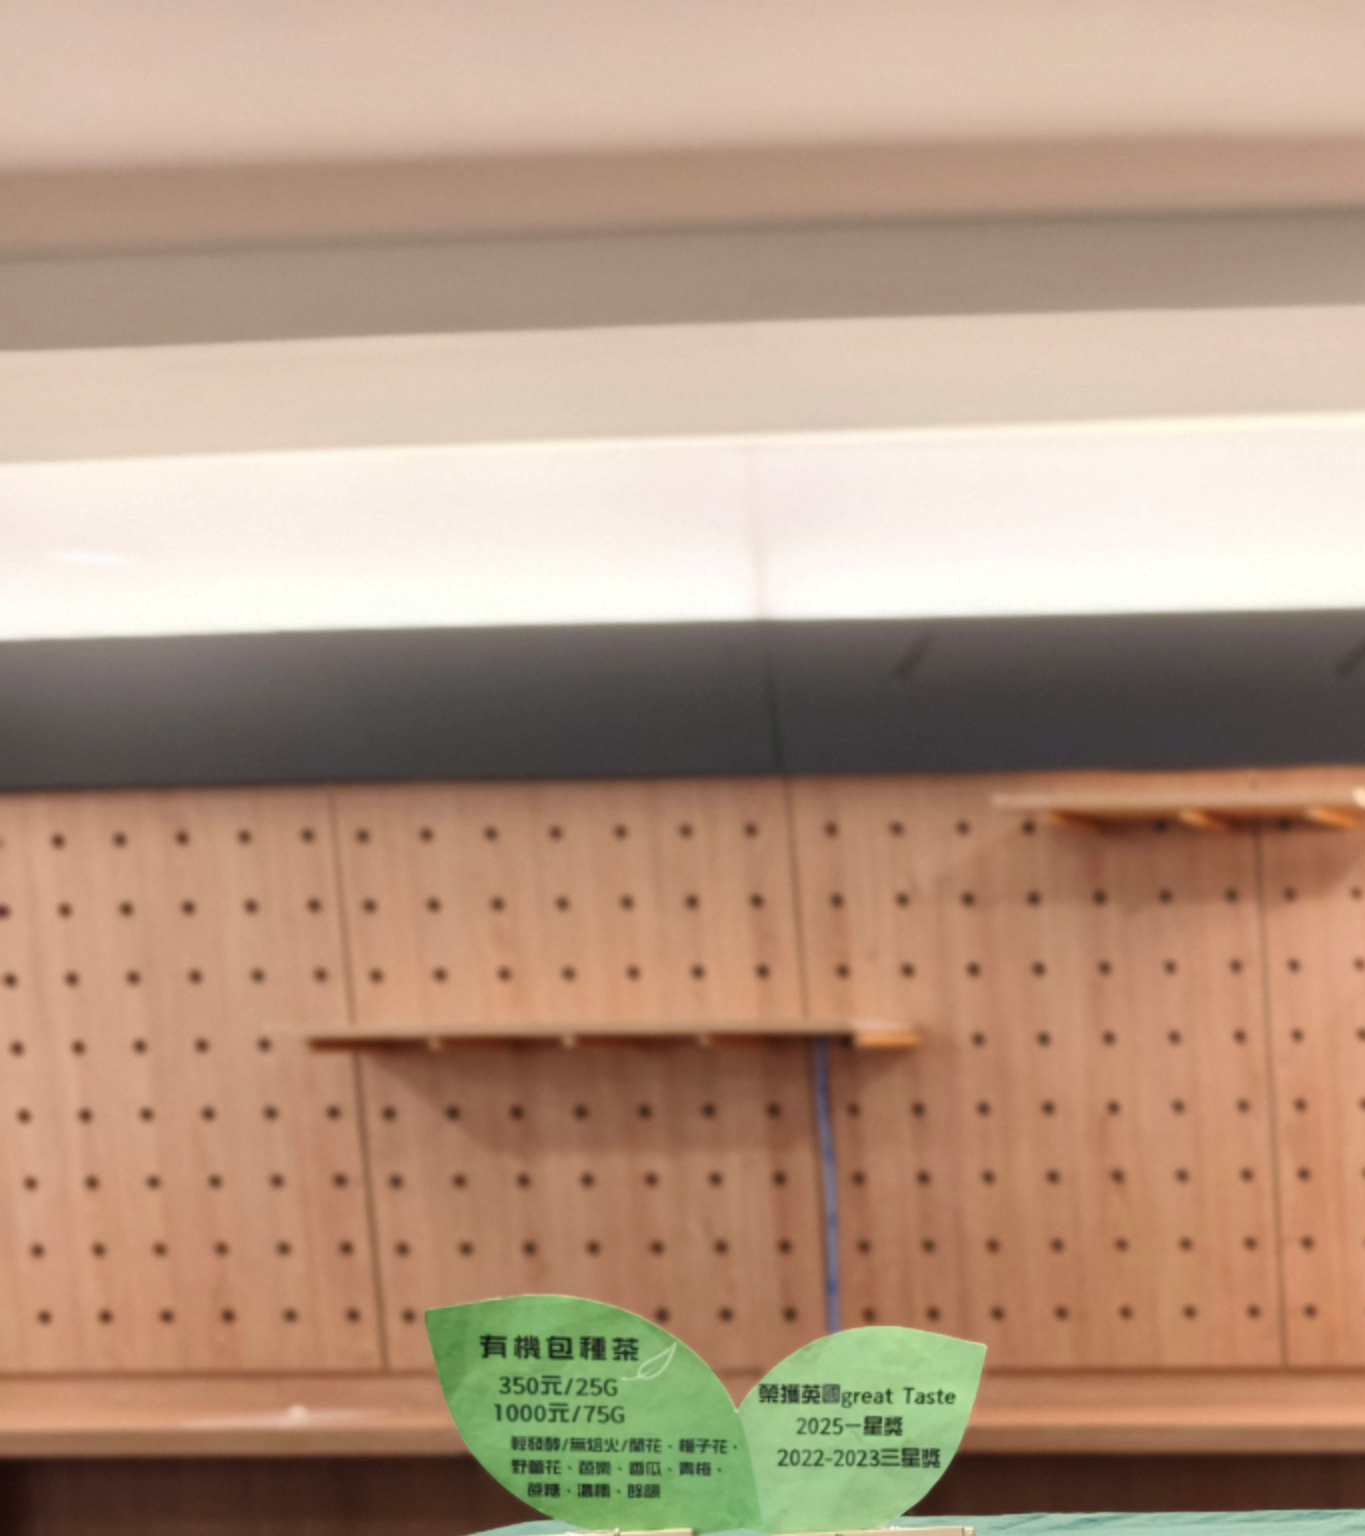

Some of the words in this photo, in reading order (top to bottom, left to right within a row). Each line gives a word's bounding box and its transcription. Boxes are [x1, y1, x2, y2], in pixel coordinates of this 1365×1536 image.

[480, 1335, 640, 1361] 有機包種茶
[499, 1375, 618, 1398] 350元/25G
[903, 1387, 957, 1405] Taste
[495, 1403, 626, 1425] 1000元/75G
[796, 1415, 904, 1438] 2025一星獎
[777, 1447, 941, 1469] 2022-2023三星獎
